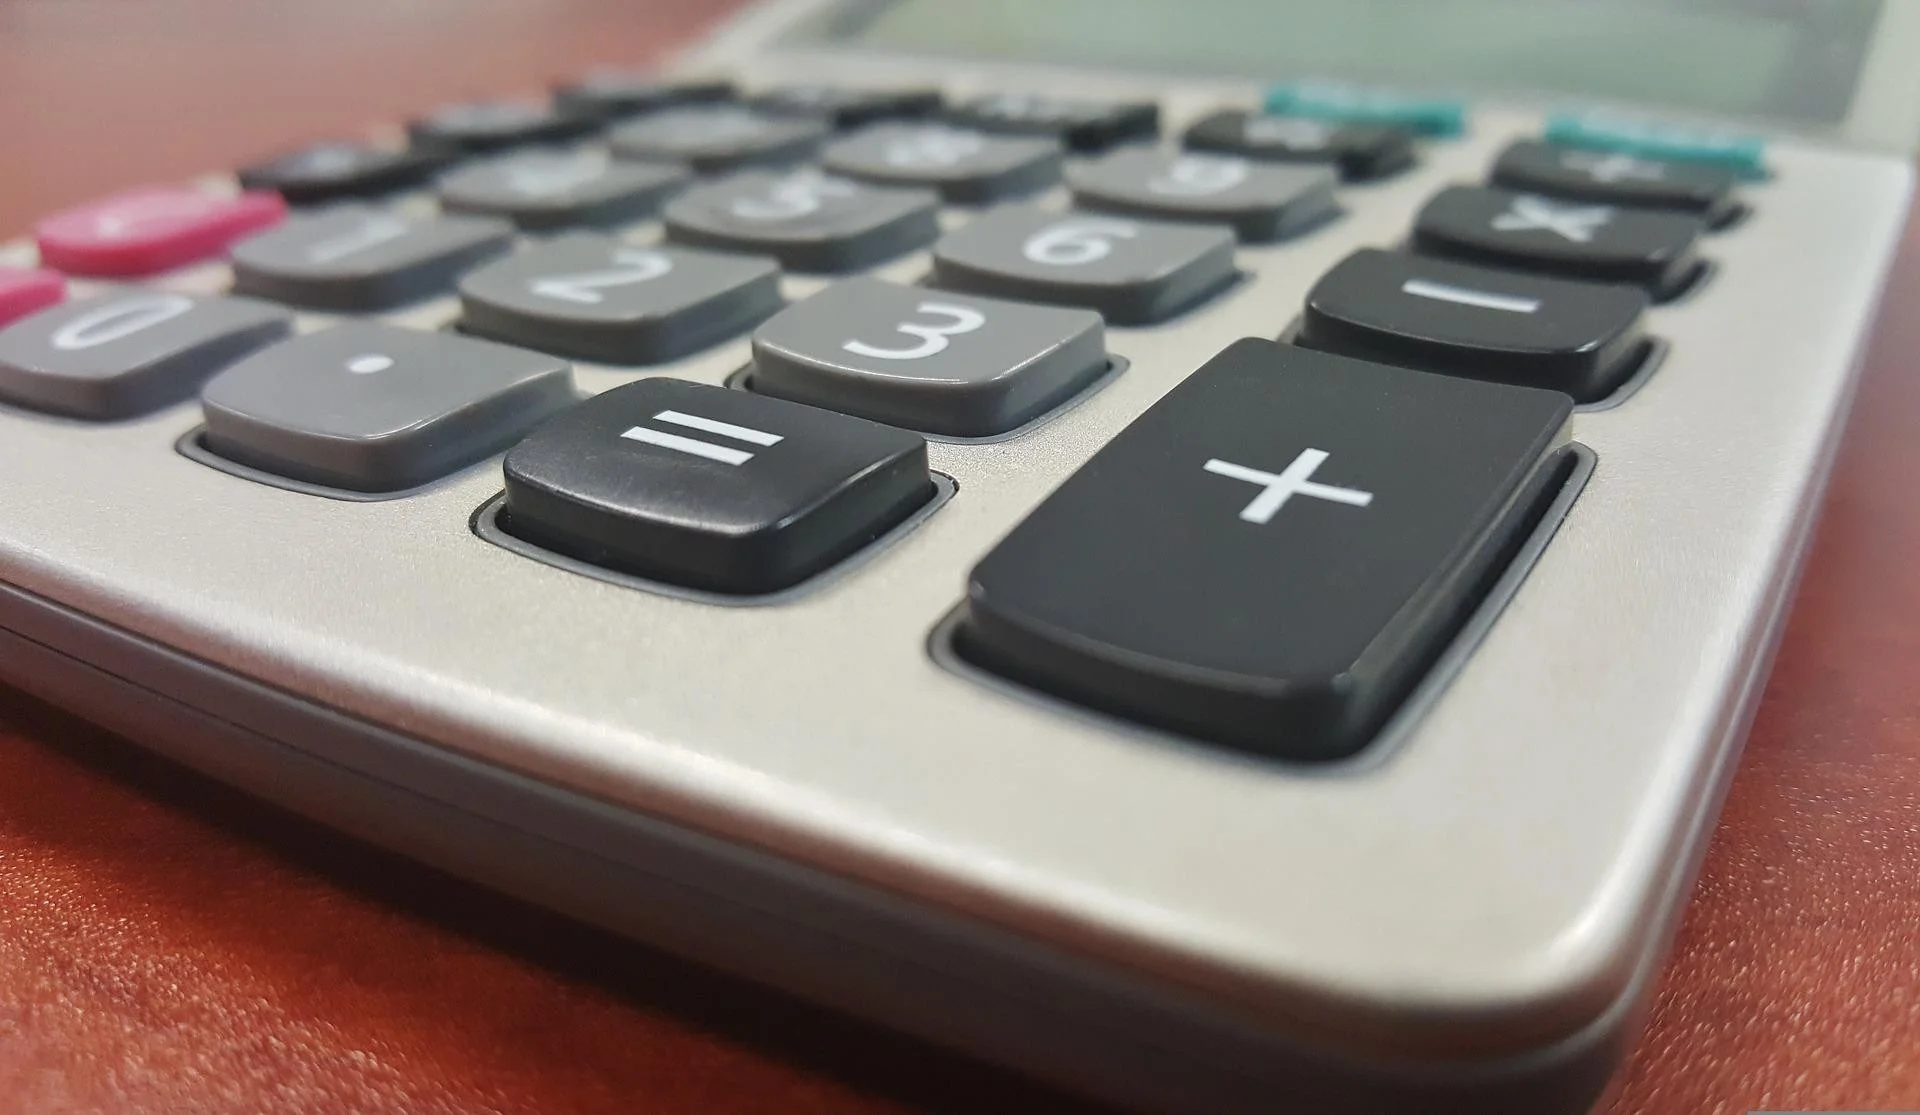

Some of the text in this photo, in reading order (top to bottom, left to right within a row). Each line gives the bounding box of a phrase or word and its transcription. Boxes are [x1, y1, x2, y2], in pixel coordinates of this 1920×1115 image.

[1022, 217, 1138, 265] 6
[530, 250, 674, 302] 2
[50, 297, 195, 349] 0
[842, 303, 986, 360] 3
[620, 409, 785, 466] =
[1202, 447, 1374, 525] +
